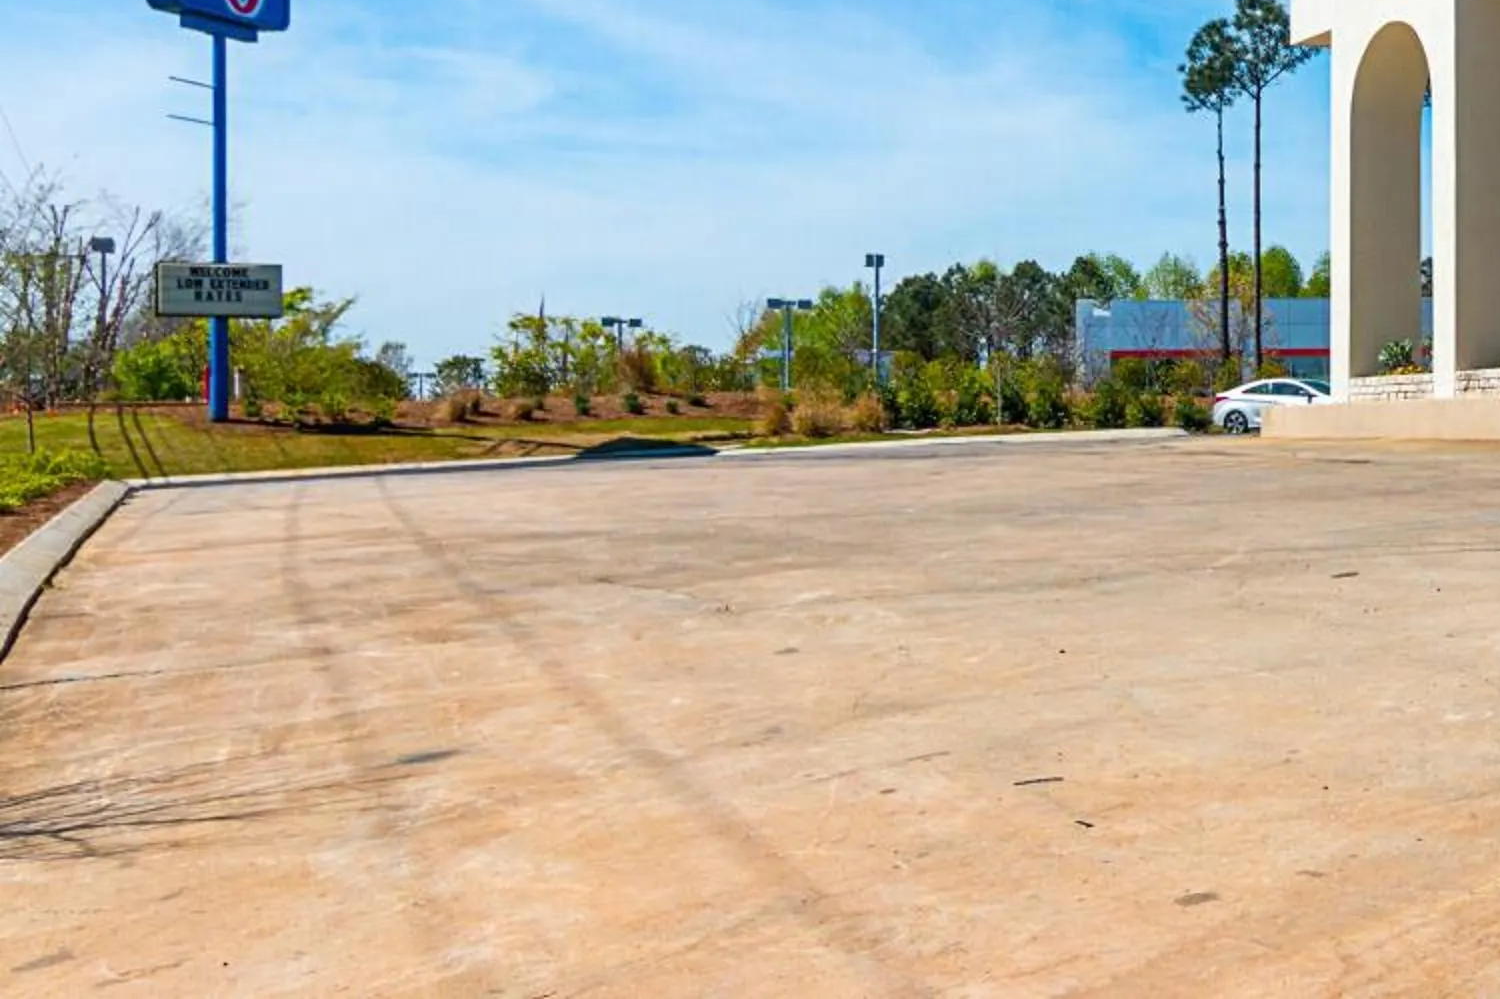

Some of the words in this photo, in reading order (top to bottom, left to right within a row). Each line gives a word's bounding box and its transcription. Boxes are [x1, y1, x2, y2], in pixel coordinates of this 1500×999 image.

[189, 267, 248, 277] WELCOME
[176, 278, 203, 289] LOW
[194, 290, 242, 301] RATES
